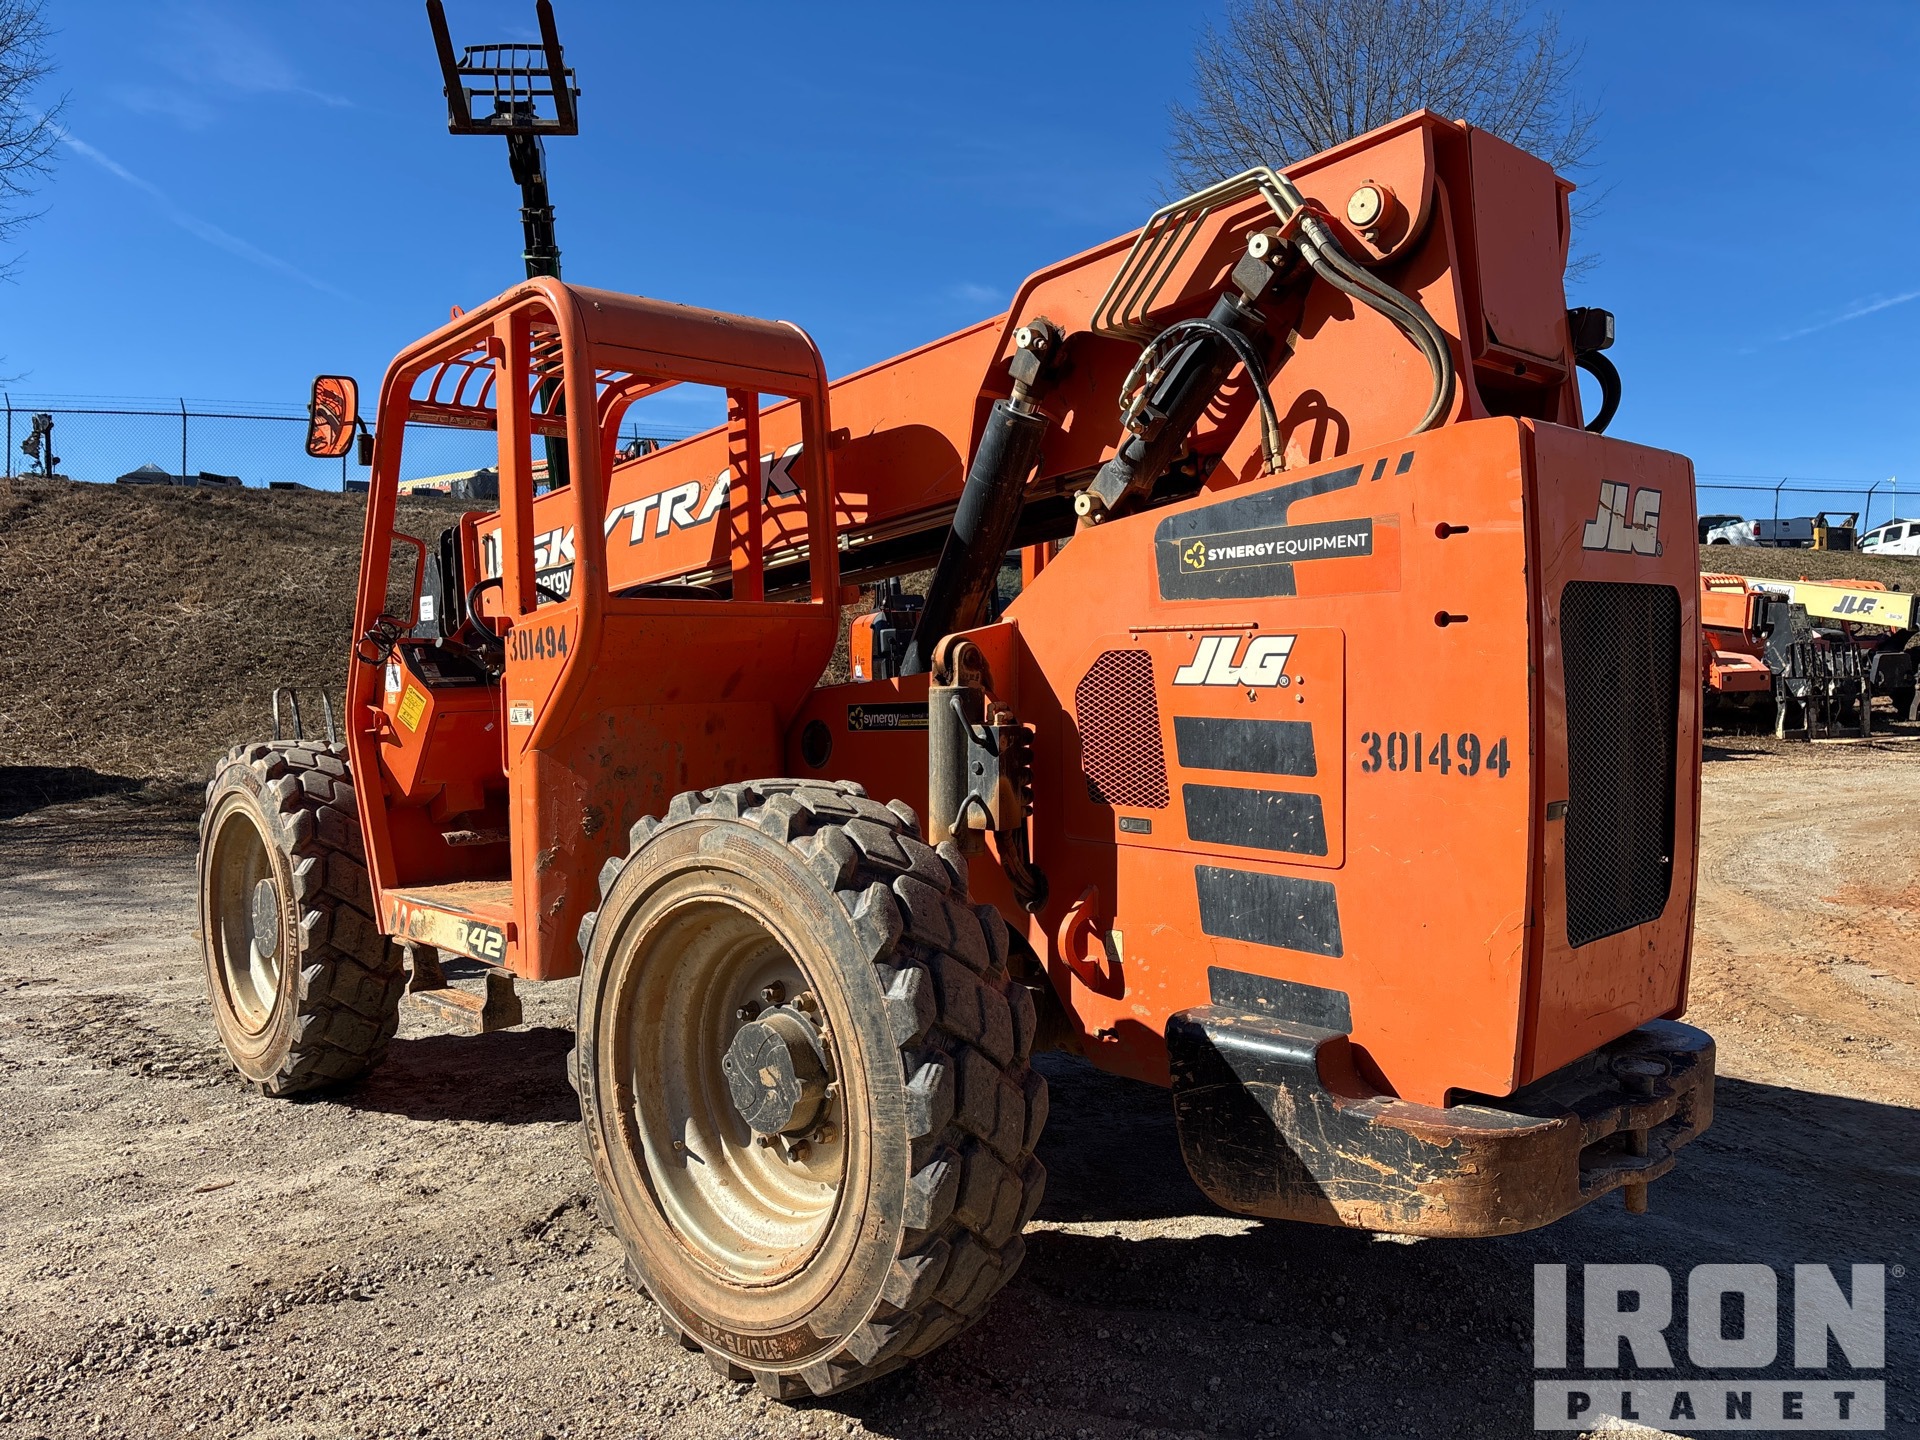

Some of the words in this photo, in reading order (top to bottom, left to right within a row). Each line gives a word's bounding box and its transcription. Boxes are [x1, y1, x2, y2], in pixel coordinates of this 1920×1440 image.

[1582, 479, 1661, 557] JLG
[1208, 542, 1275, 561] SYNERGY
[1276, 533, 1369, 555] EQUIPMENT
[1833, 595, 1877, 615] JLG
[508, 625, 567, 662] 301494
[1172, 634, 1298, 688] JLG
[864, 714, 899, 727] synergy
[1361, 731, 1511, 778] 301494
[581, 1062, 601, 1152] CAMSO
